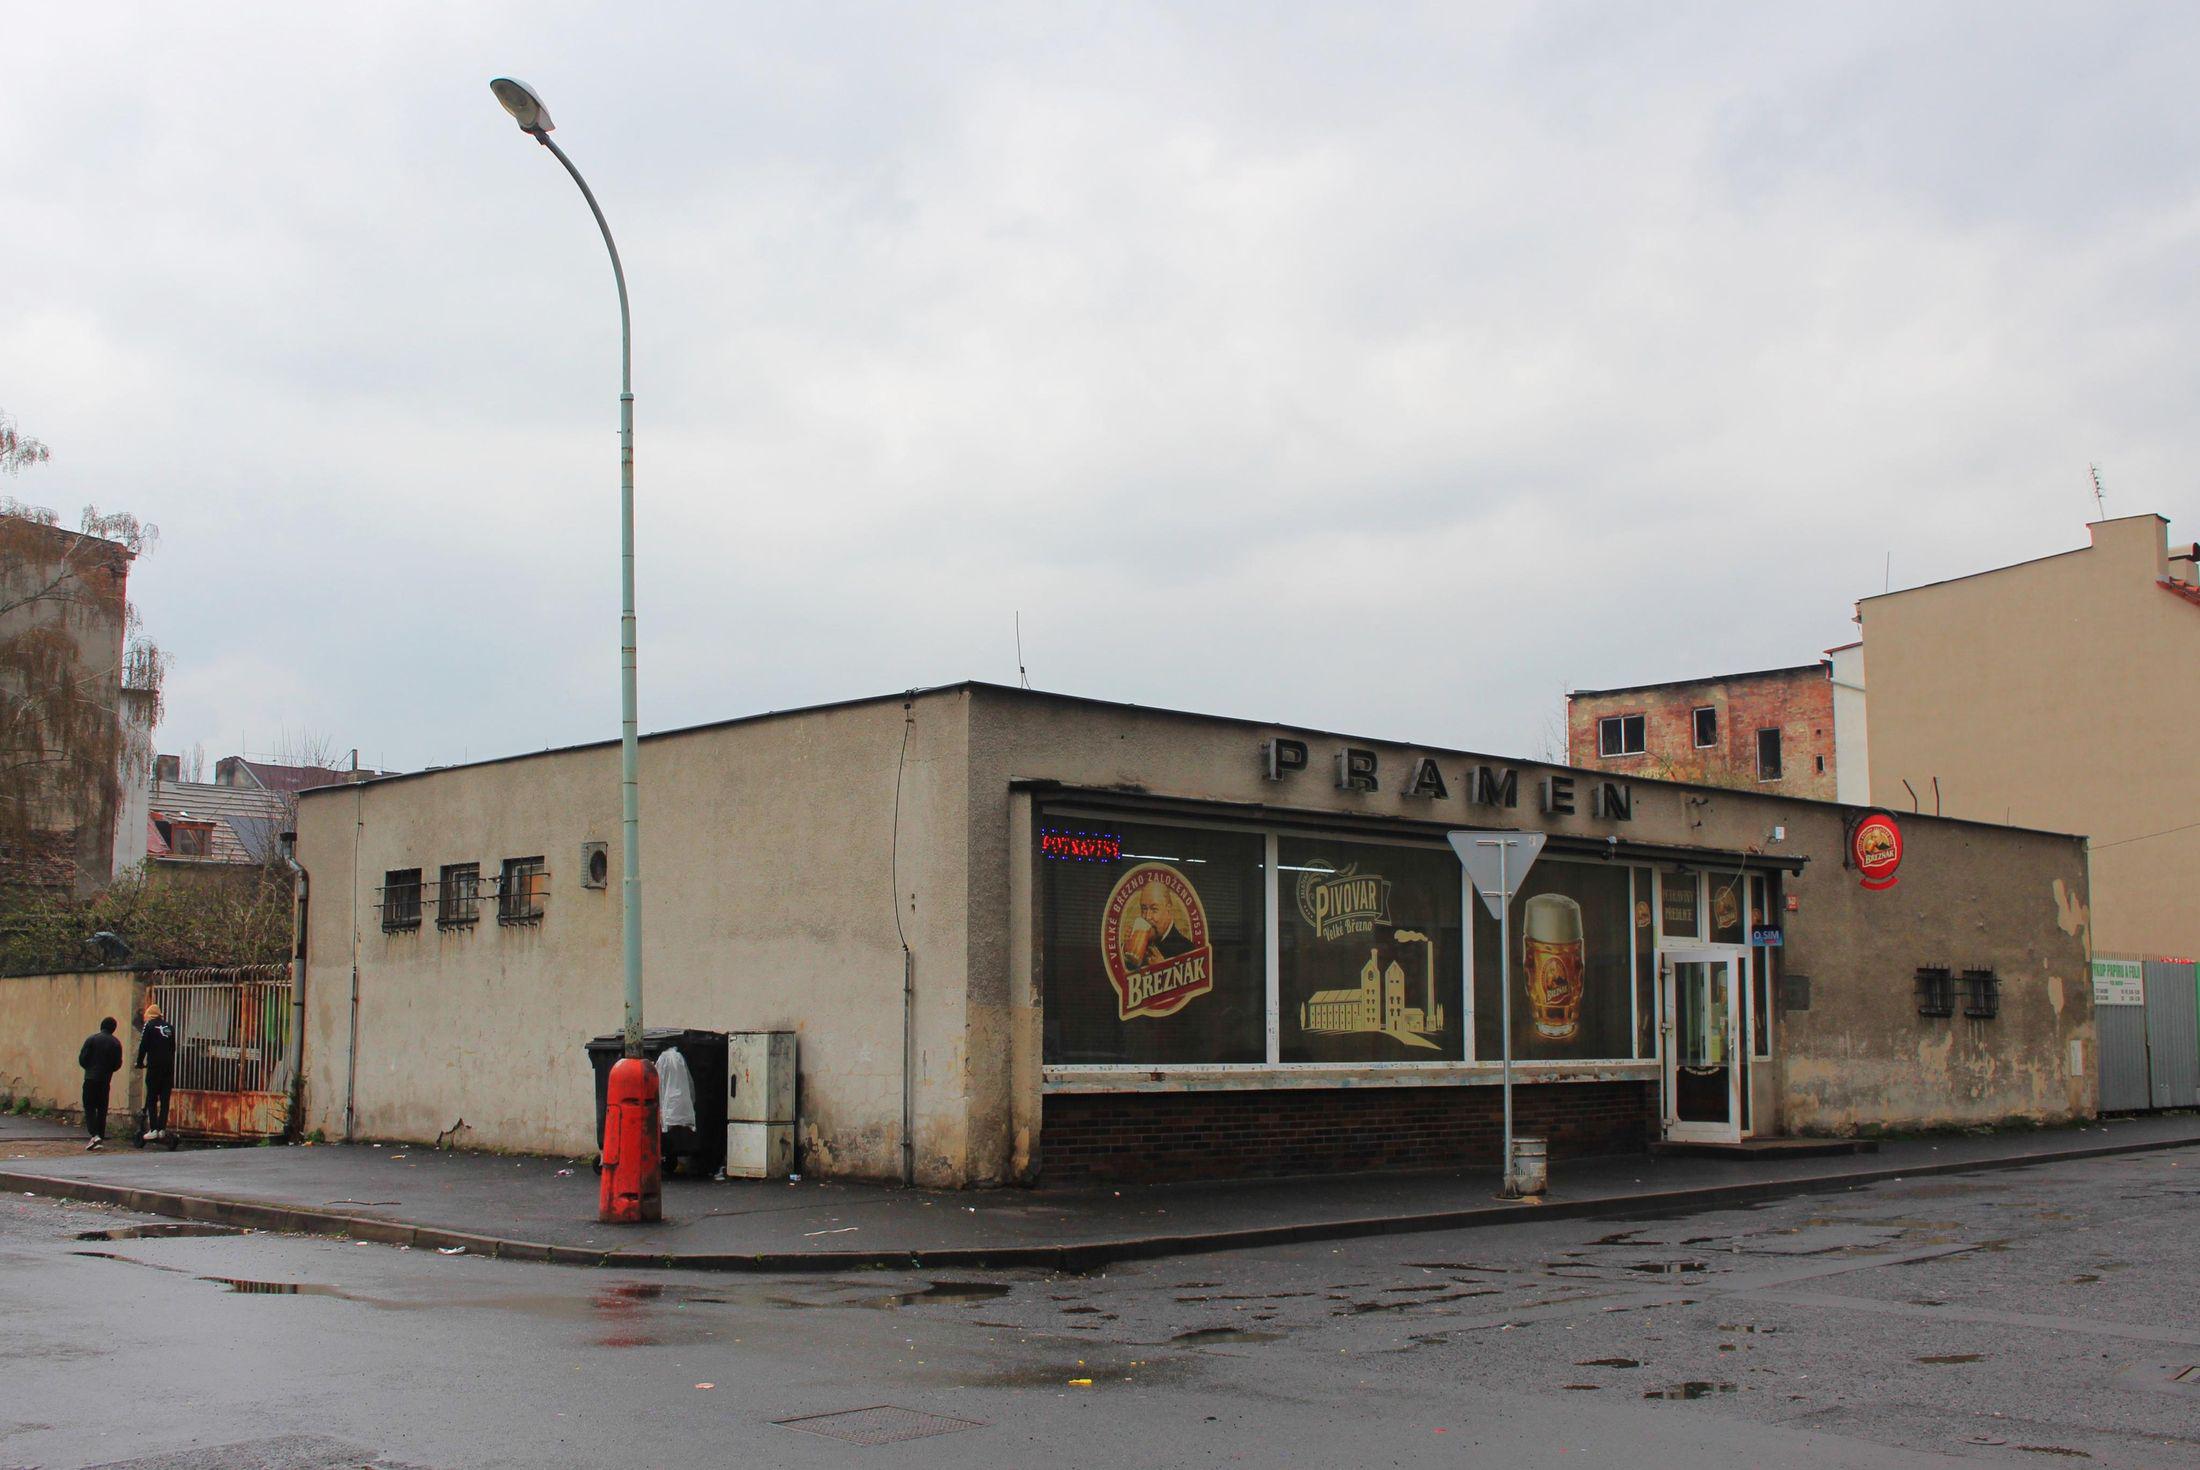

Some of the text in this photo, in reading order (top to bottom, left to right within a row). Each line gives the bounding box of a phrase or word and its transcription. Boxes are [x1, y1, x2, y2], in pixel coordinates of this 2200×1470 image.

[1268, 736, 1632, 822] PRAMEN
[1316, 880, 1377, 938] PIVOVAR
[1126, 956, 1207, 1009] BŘEZŇÁK
